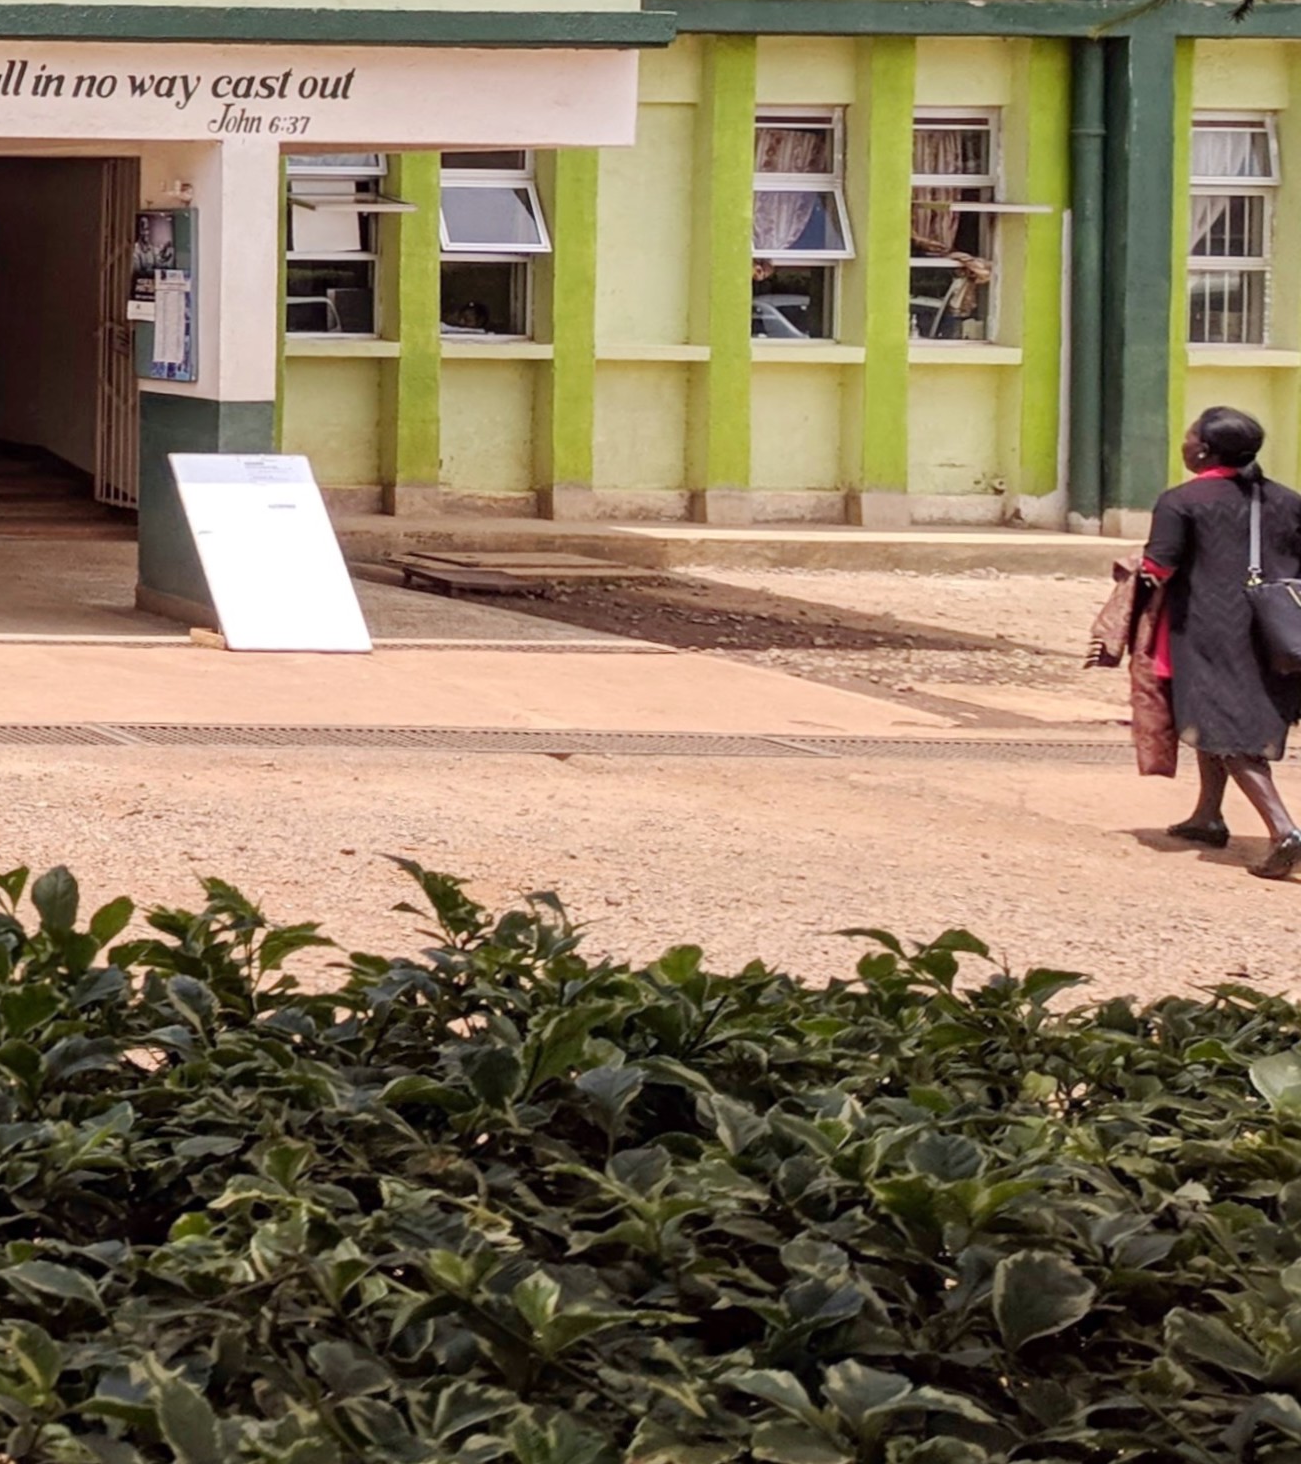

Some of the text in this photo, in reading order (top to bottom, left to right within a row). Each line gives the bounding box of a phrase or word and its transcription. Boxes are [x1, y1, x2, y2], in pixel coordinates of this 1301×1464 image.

[31, 64, 65, 97] in
[72, 75, 118, 99] no
[127, 75, 201, 110] way
[211, 68, 293, 99] cast
[298, 67, 356, 100] out
[207, 103, 311, 135] John 6:37
